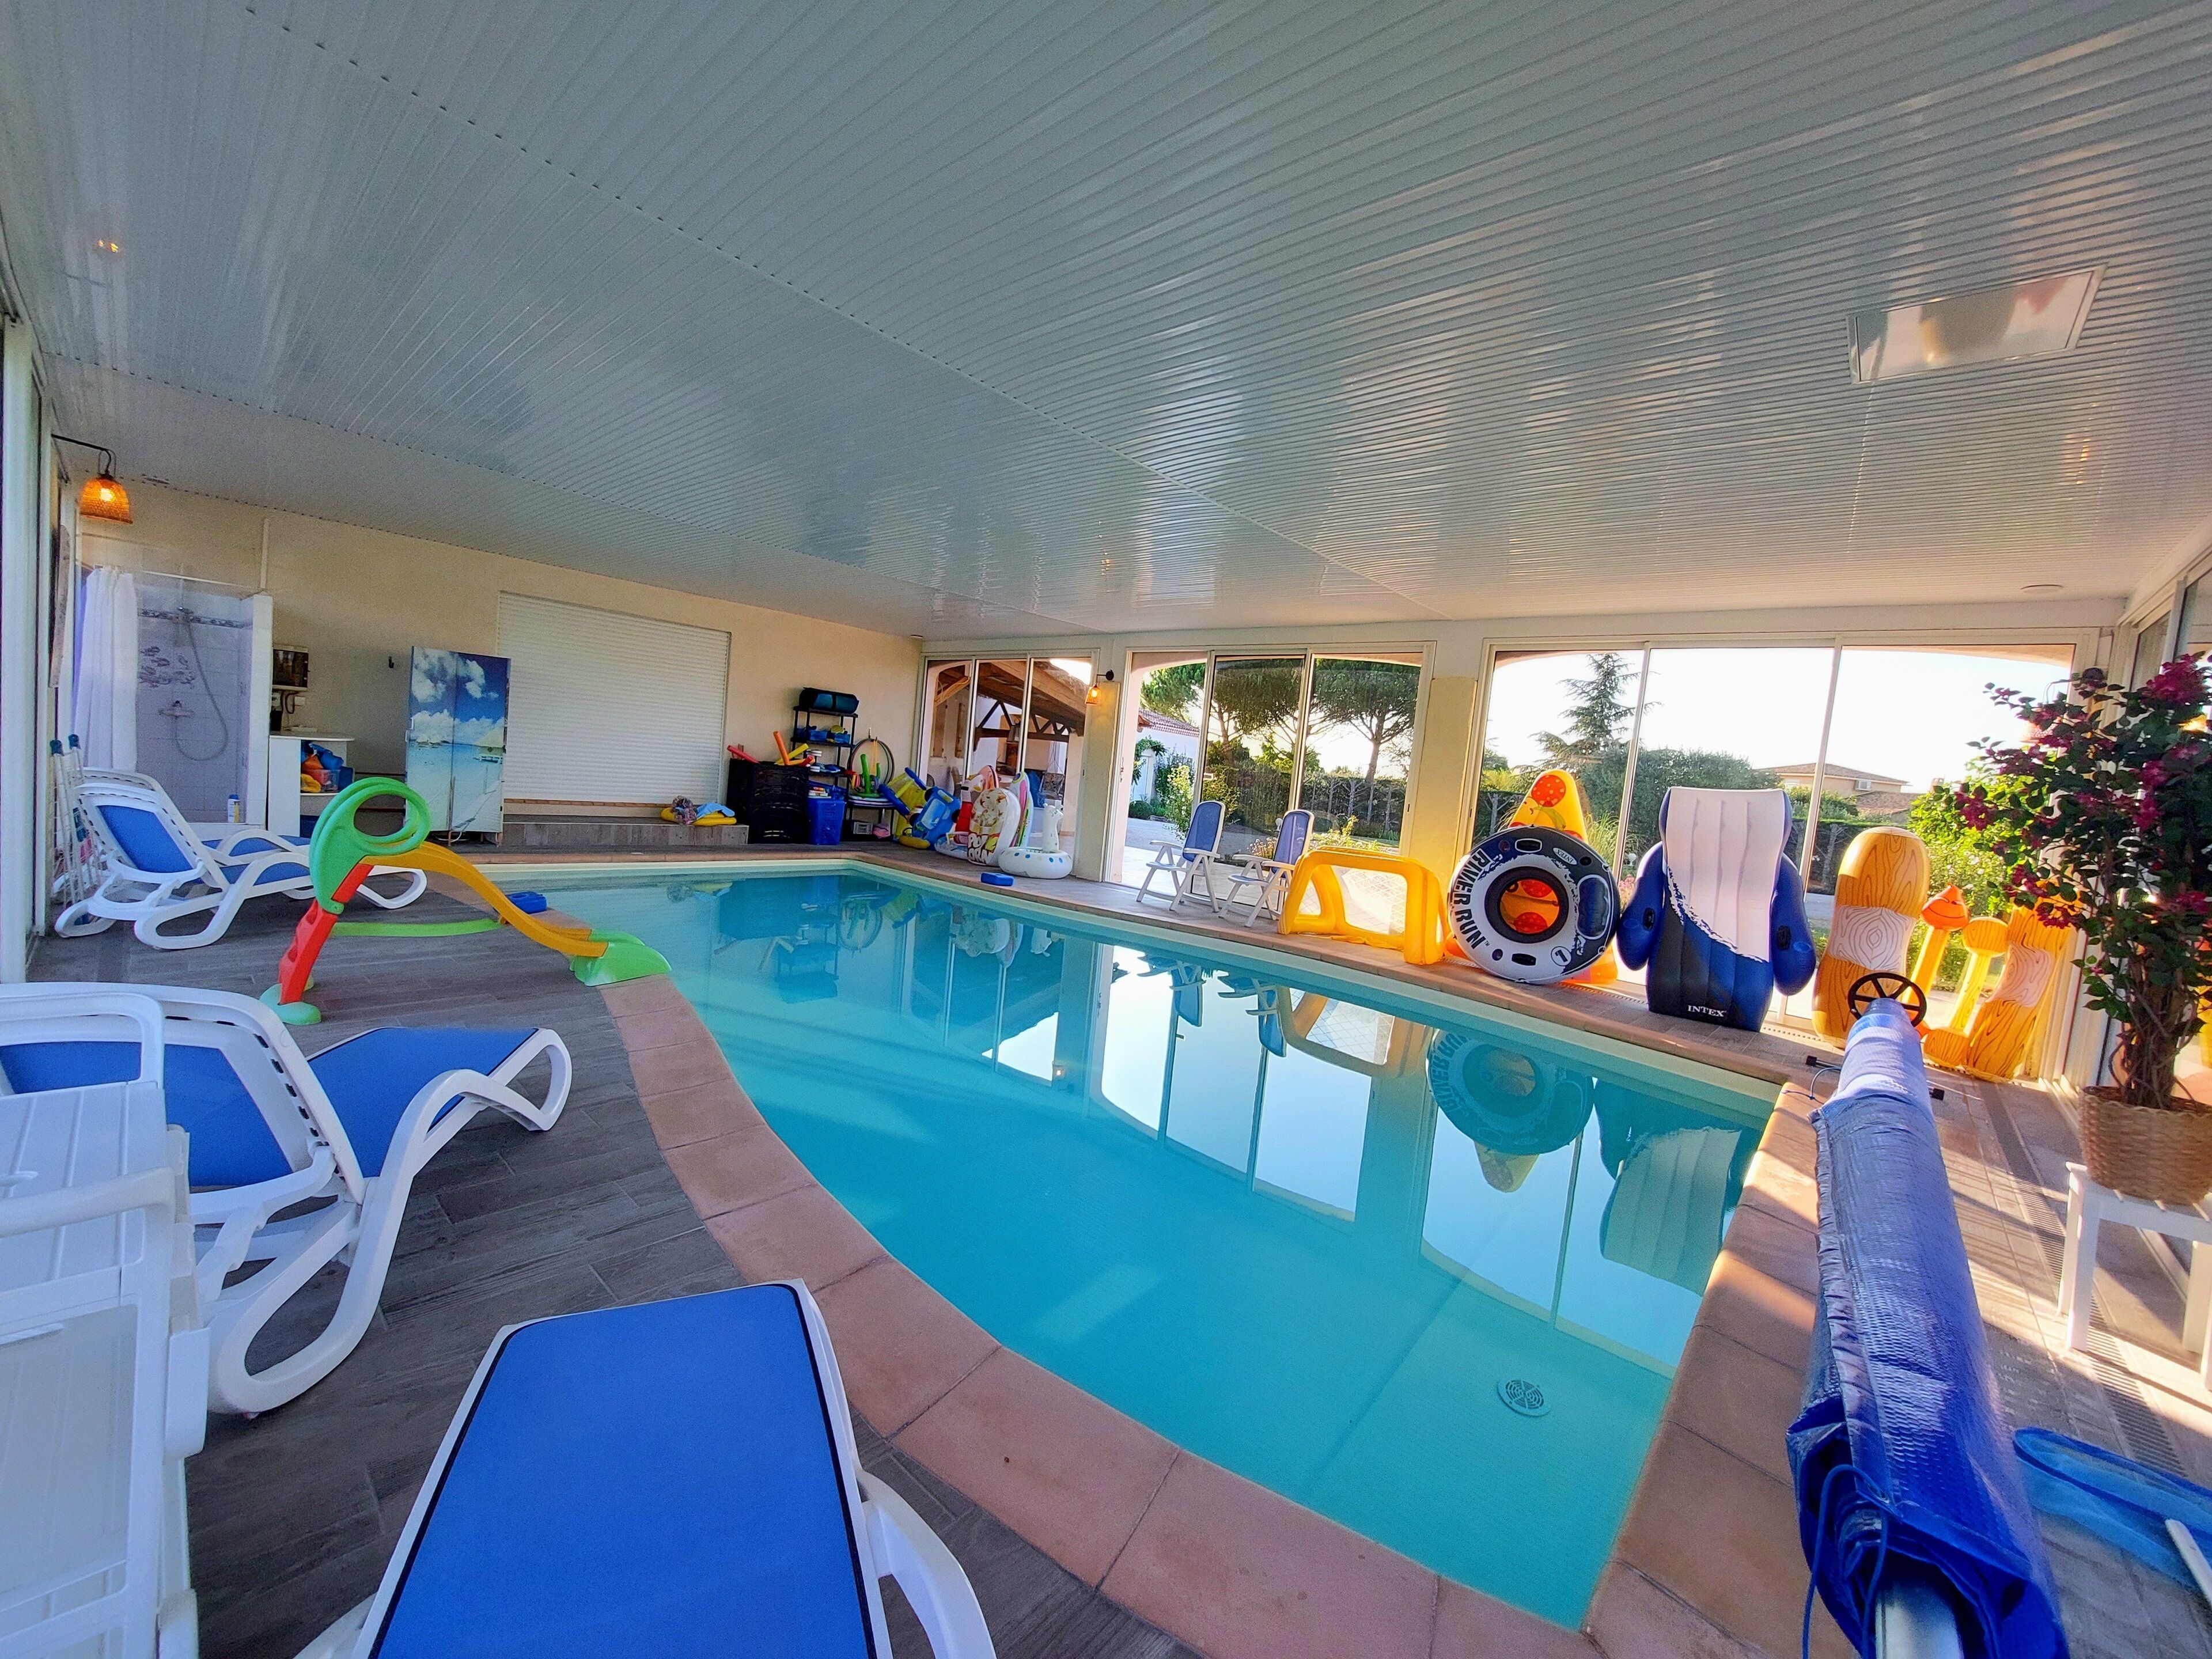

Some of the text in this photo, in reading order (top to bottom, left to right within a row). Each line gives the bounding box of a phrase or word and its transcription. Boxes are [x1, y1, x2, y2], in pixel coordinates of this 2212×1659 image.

[1557, 849, 1574, 863] INTEX
[1453, 848, 1492, 906] RIVER
[1455, 908, 1486, 949] RUN
[1687, 1005, 1724, 1017] INTEX
